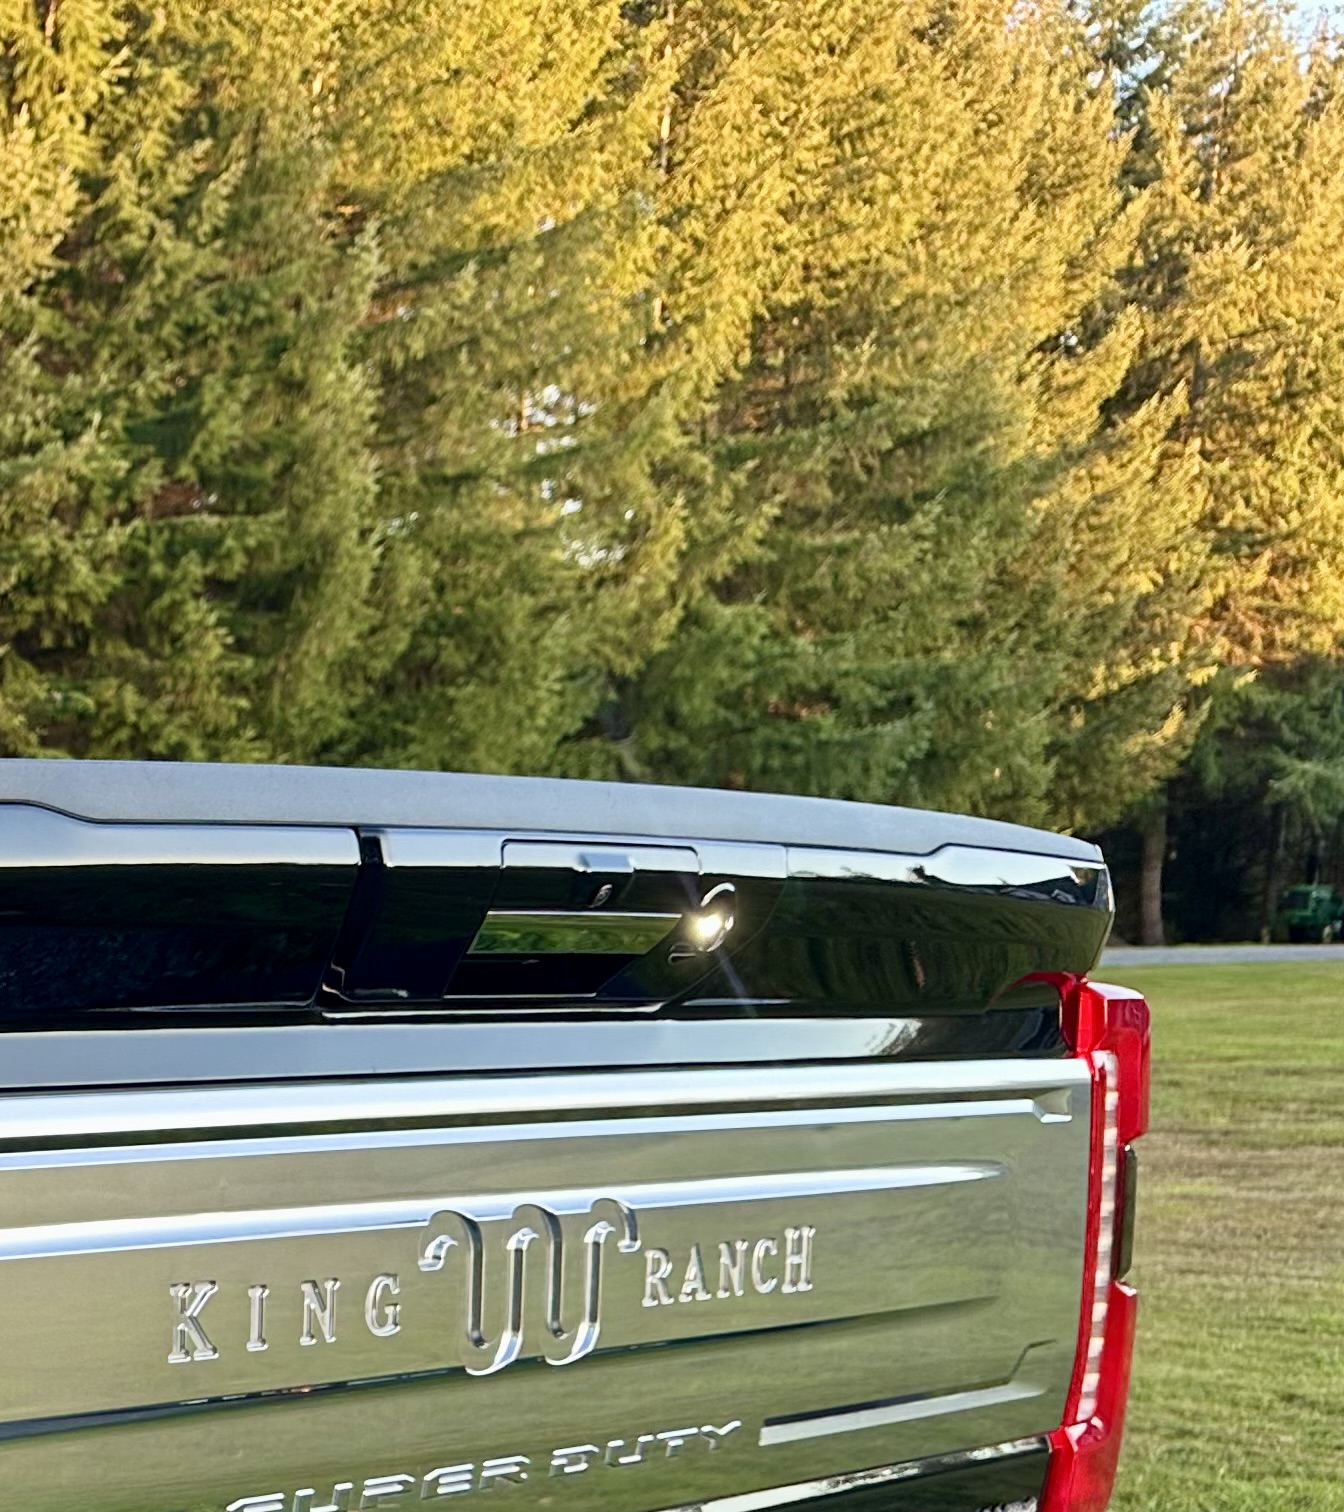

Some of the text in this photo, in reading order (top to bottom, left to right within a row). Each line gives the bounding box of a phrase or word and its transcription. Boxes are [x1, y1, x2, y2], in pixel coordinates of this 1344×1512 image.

[167, 1272, 402, 1364] KING
[642, 1225, 817, 1308] RANCH
[548, 1419, 743, 1478] DUTY
